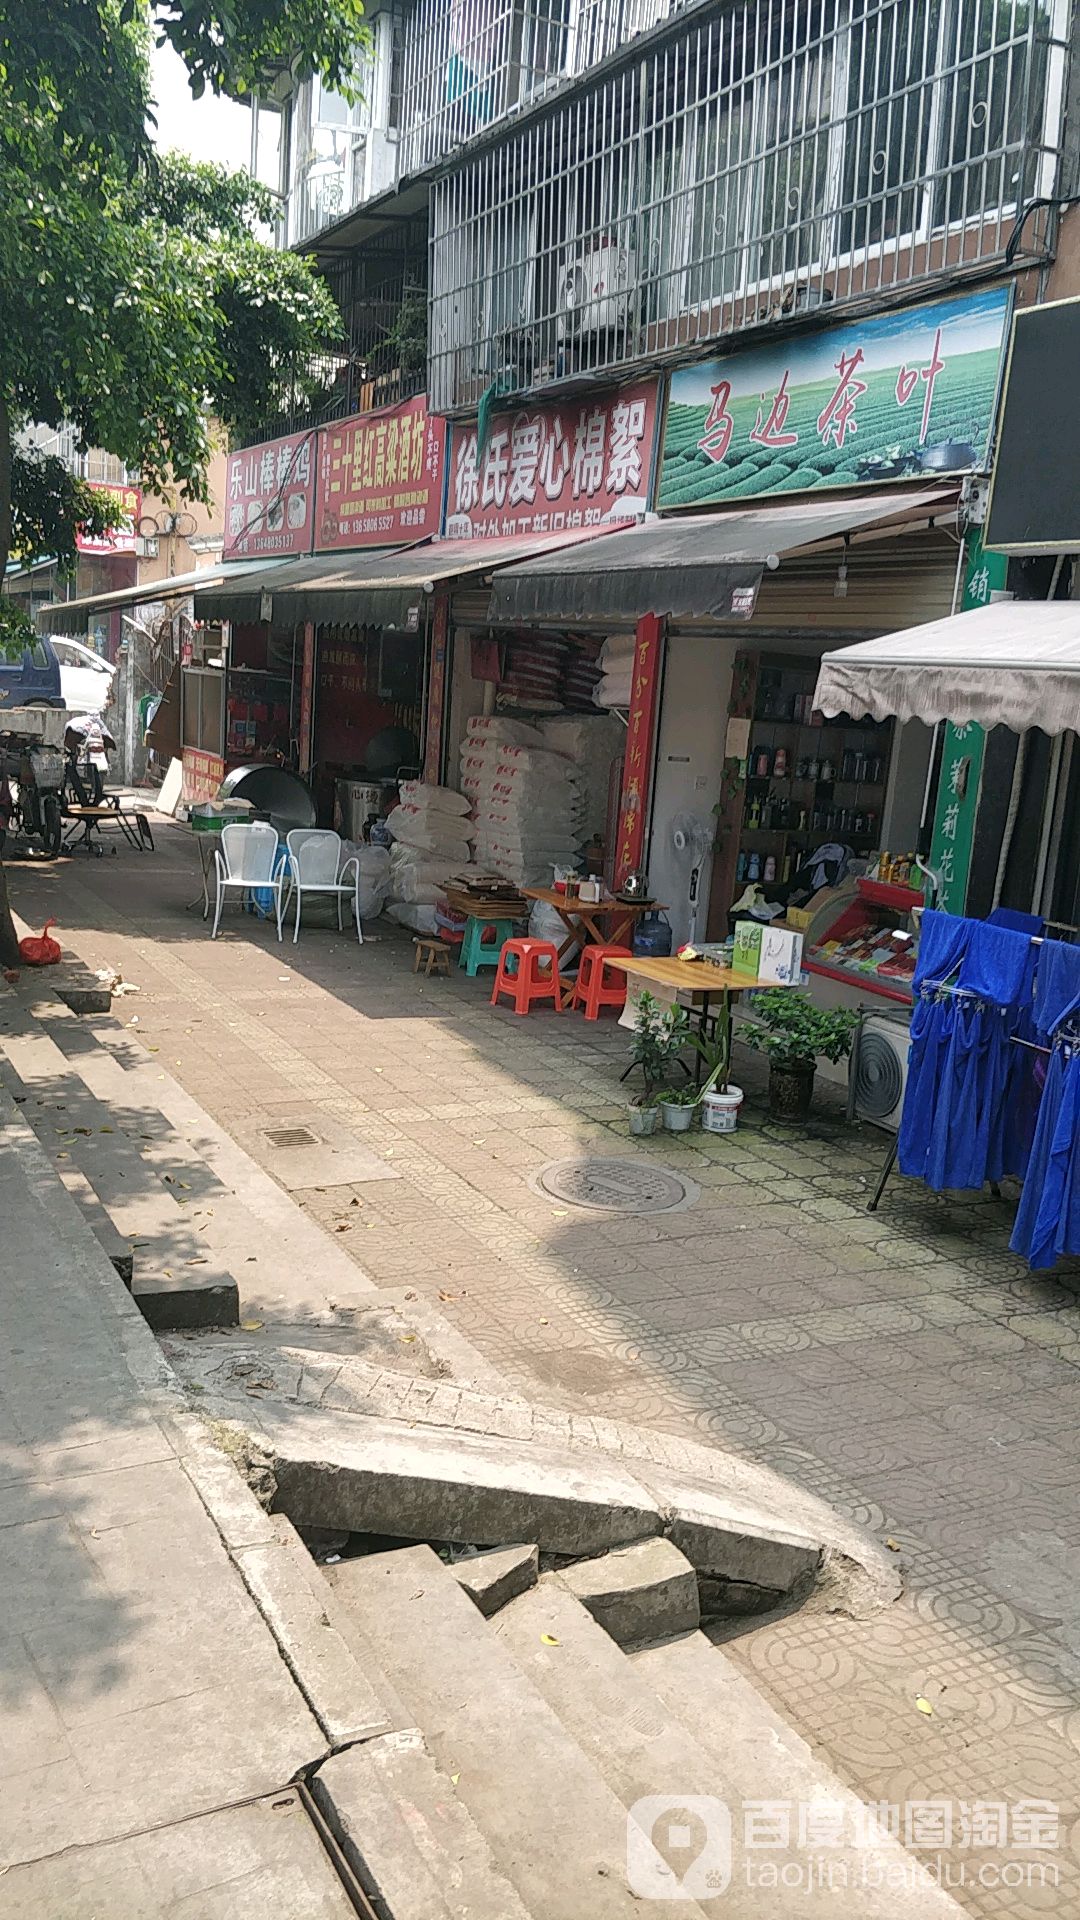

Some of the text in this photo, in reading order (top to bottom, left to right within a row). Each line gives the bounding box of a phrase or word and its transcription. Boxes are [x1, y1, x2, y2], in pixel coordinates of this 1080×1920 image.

[697, 327, 946, 465] 马边茶叶
[229, 439, 311, 501] 乐山棒棒鸡
[330, 409, 425, 495] 三十里红高粱酒坊
[456, 398, 647, 513] 徐氏爱心棉絮
[967, 565, 990, 603] 销
